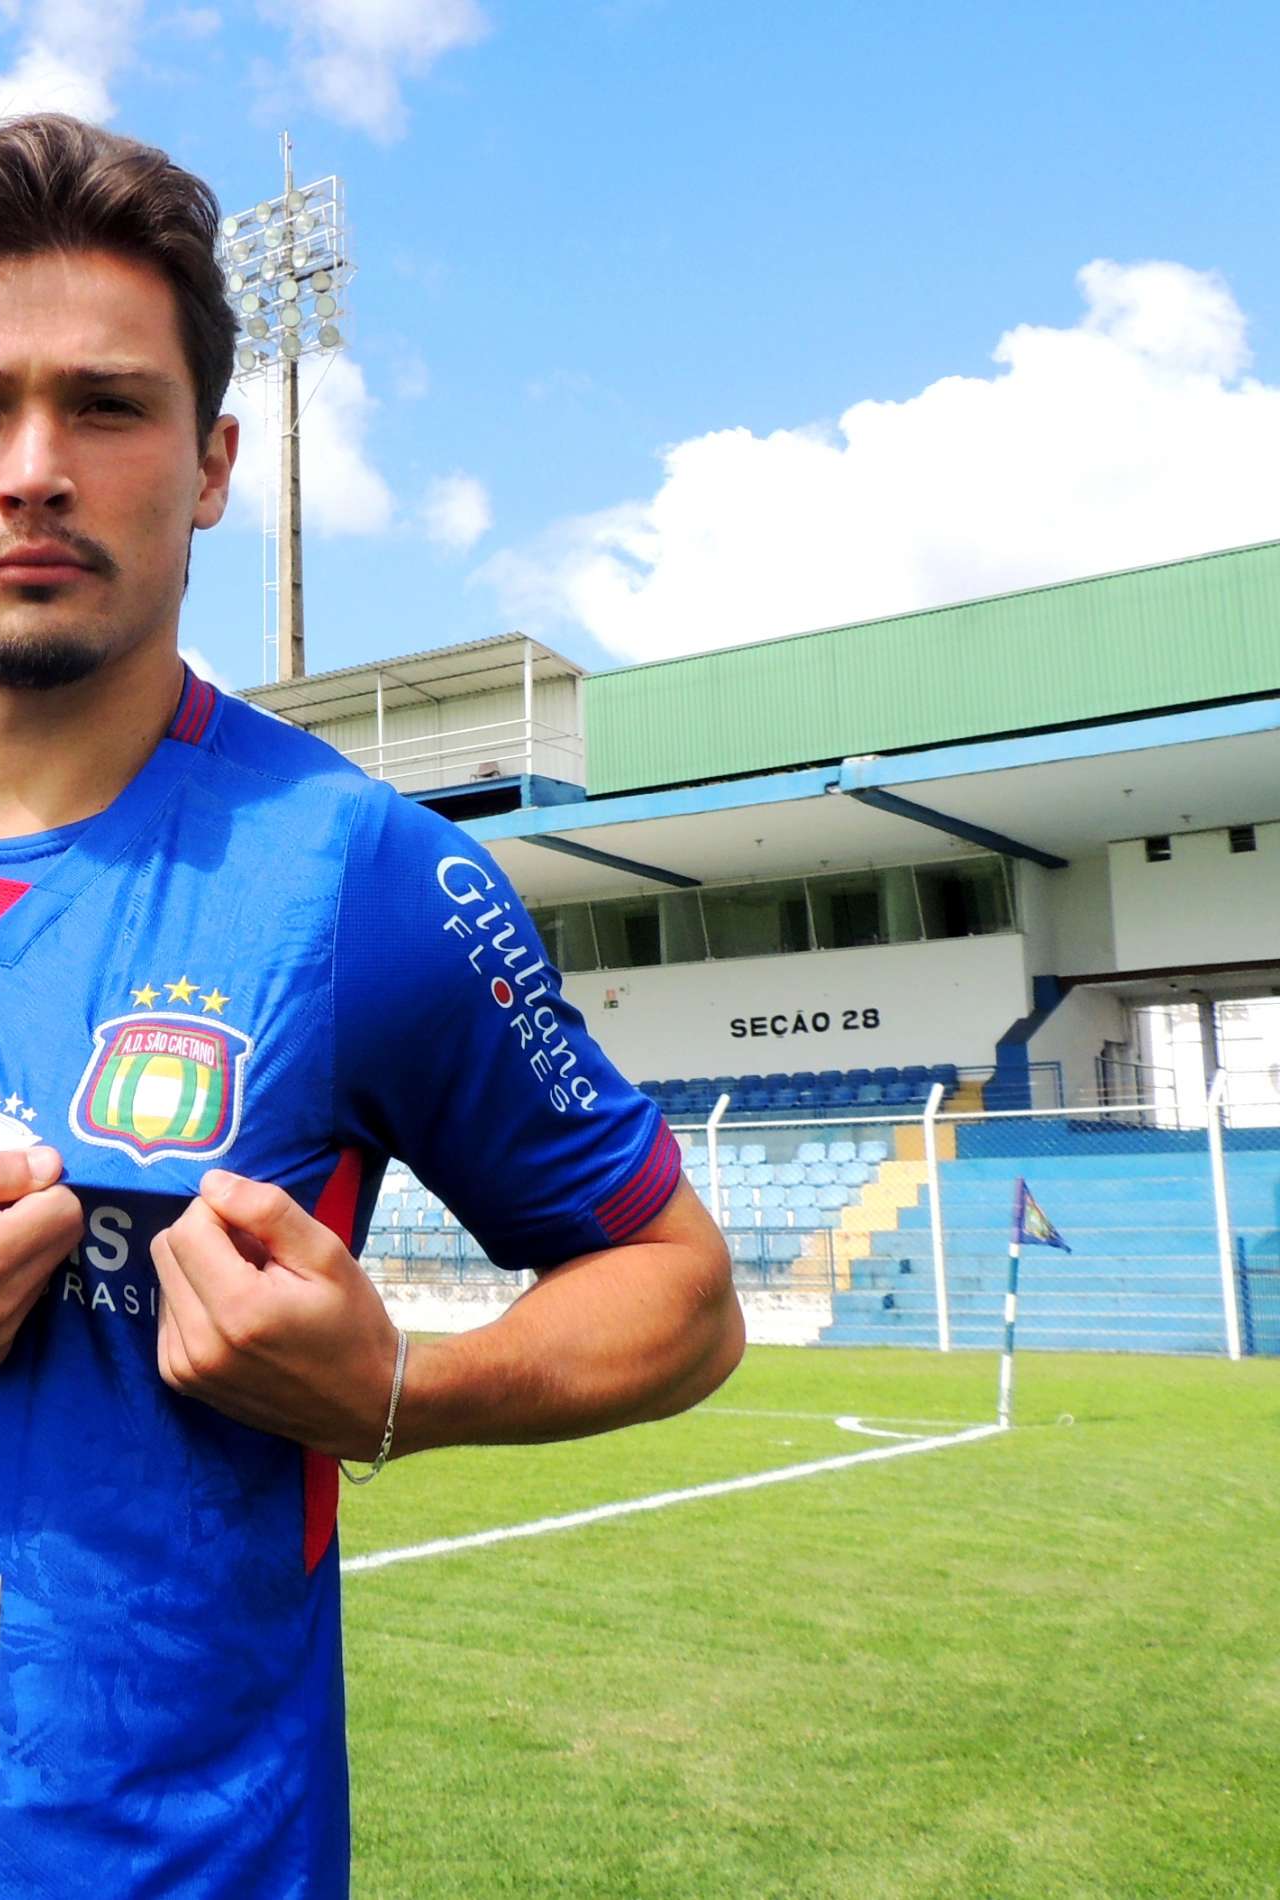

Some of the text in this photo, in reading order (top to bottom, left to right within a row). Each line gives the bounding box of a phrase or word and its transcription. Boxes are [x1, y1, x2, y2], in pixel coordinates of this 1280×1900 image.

[436, 856, 599, 1111] Giuliana
[443, 915, 570, 1112] FLORES
[730, 1008, 880, 1038] SEÇÃO 28
[145, 1031, 168, 1052] SÃO
[167, 1035, 215, 1066] CAETANO
[38, 1272, 157, 1316] RASI
